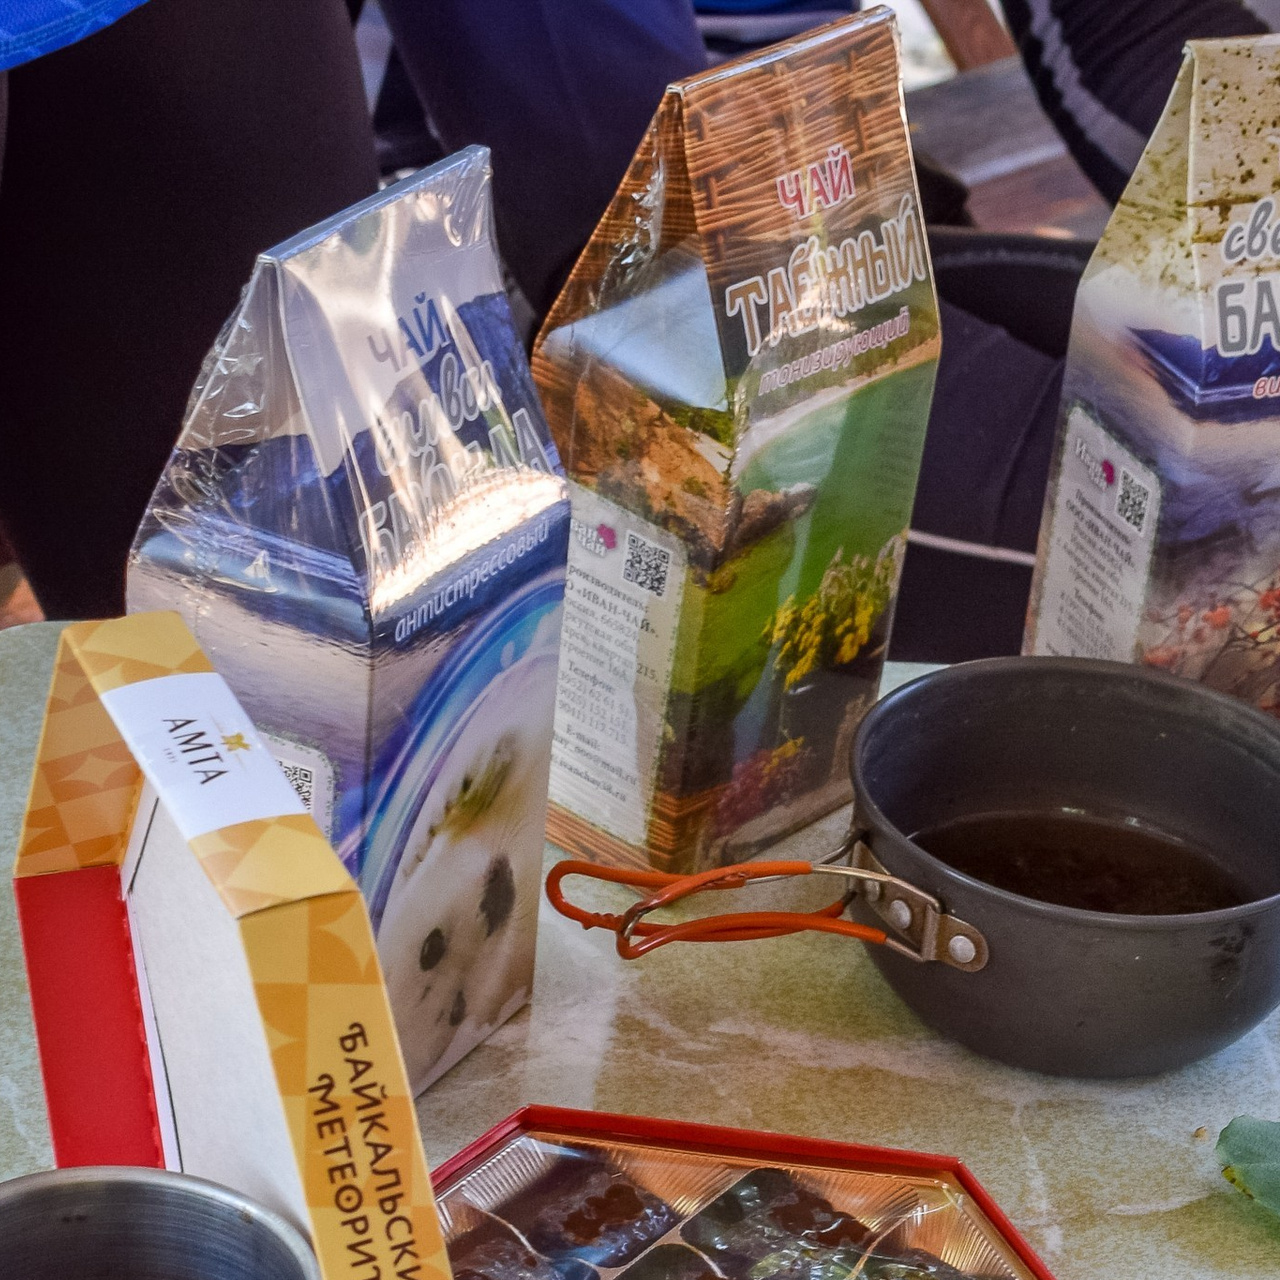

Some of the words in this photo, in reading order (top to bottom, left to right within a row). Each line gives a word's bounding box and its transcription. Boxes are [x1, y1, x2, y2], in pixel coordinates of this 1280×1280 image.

[777, 143, 855, 219] ЧАЙ
[366, 292, 447, 373] ЧАЙ
[758, 305, 911, 396] тонизирующий
[394, 516, 550, 642] антистрессовый
[569, 565, 649, 612] роизводитель:
